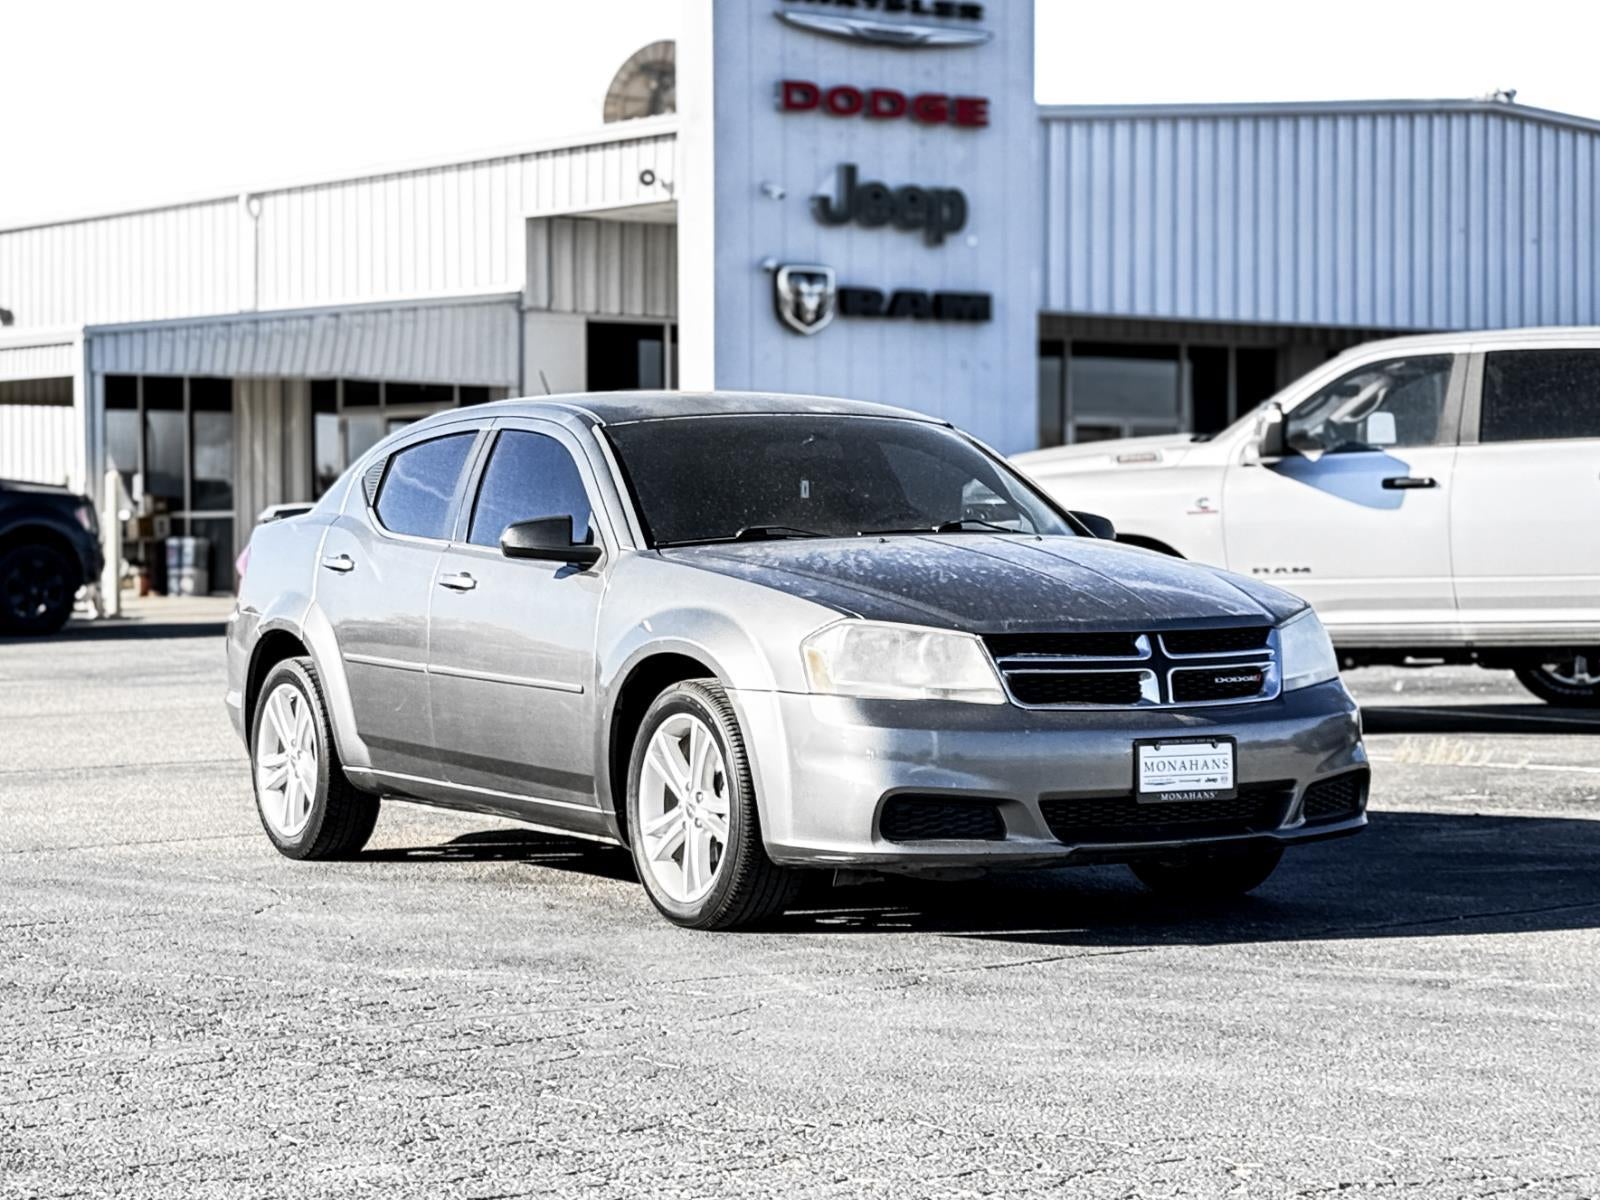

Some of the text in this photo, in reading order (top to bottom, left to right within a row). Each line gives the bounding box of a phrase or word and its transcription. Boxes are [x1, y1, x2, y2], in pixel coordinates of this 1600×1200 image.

[783, 0, 983, 21] YSLER
[777, 79, 990, 128] DODGE
[810, 163, 968, 247] Jeep
[837, 286, 991, 322] RAM
[1252, 566, 1312, 575] RAM
[1215, 675, 1257, 683] DODGE
[1144, 759, 1229, 773] MONAHANS
[1160, 791, 1216, 801] MONAHANS
